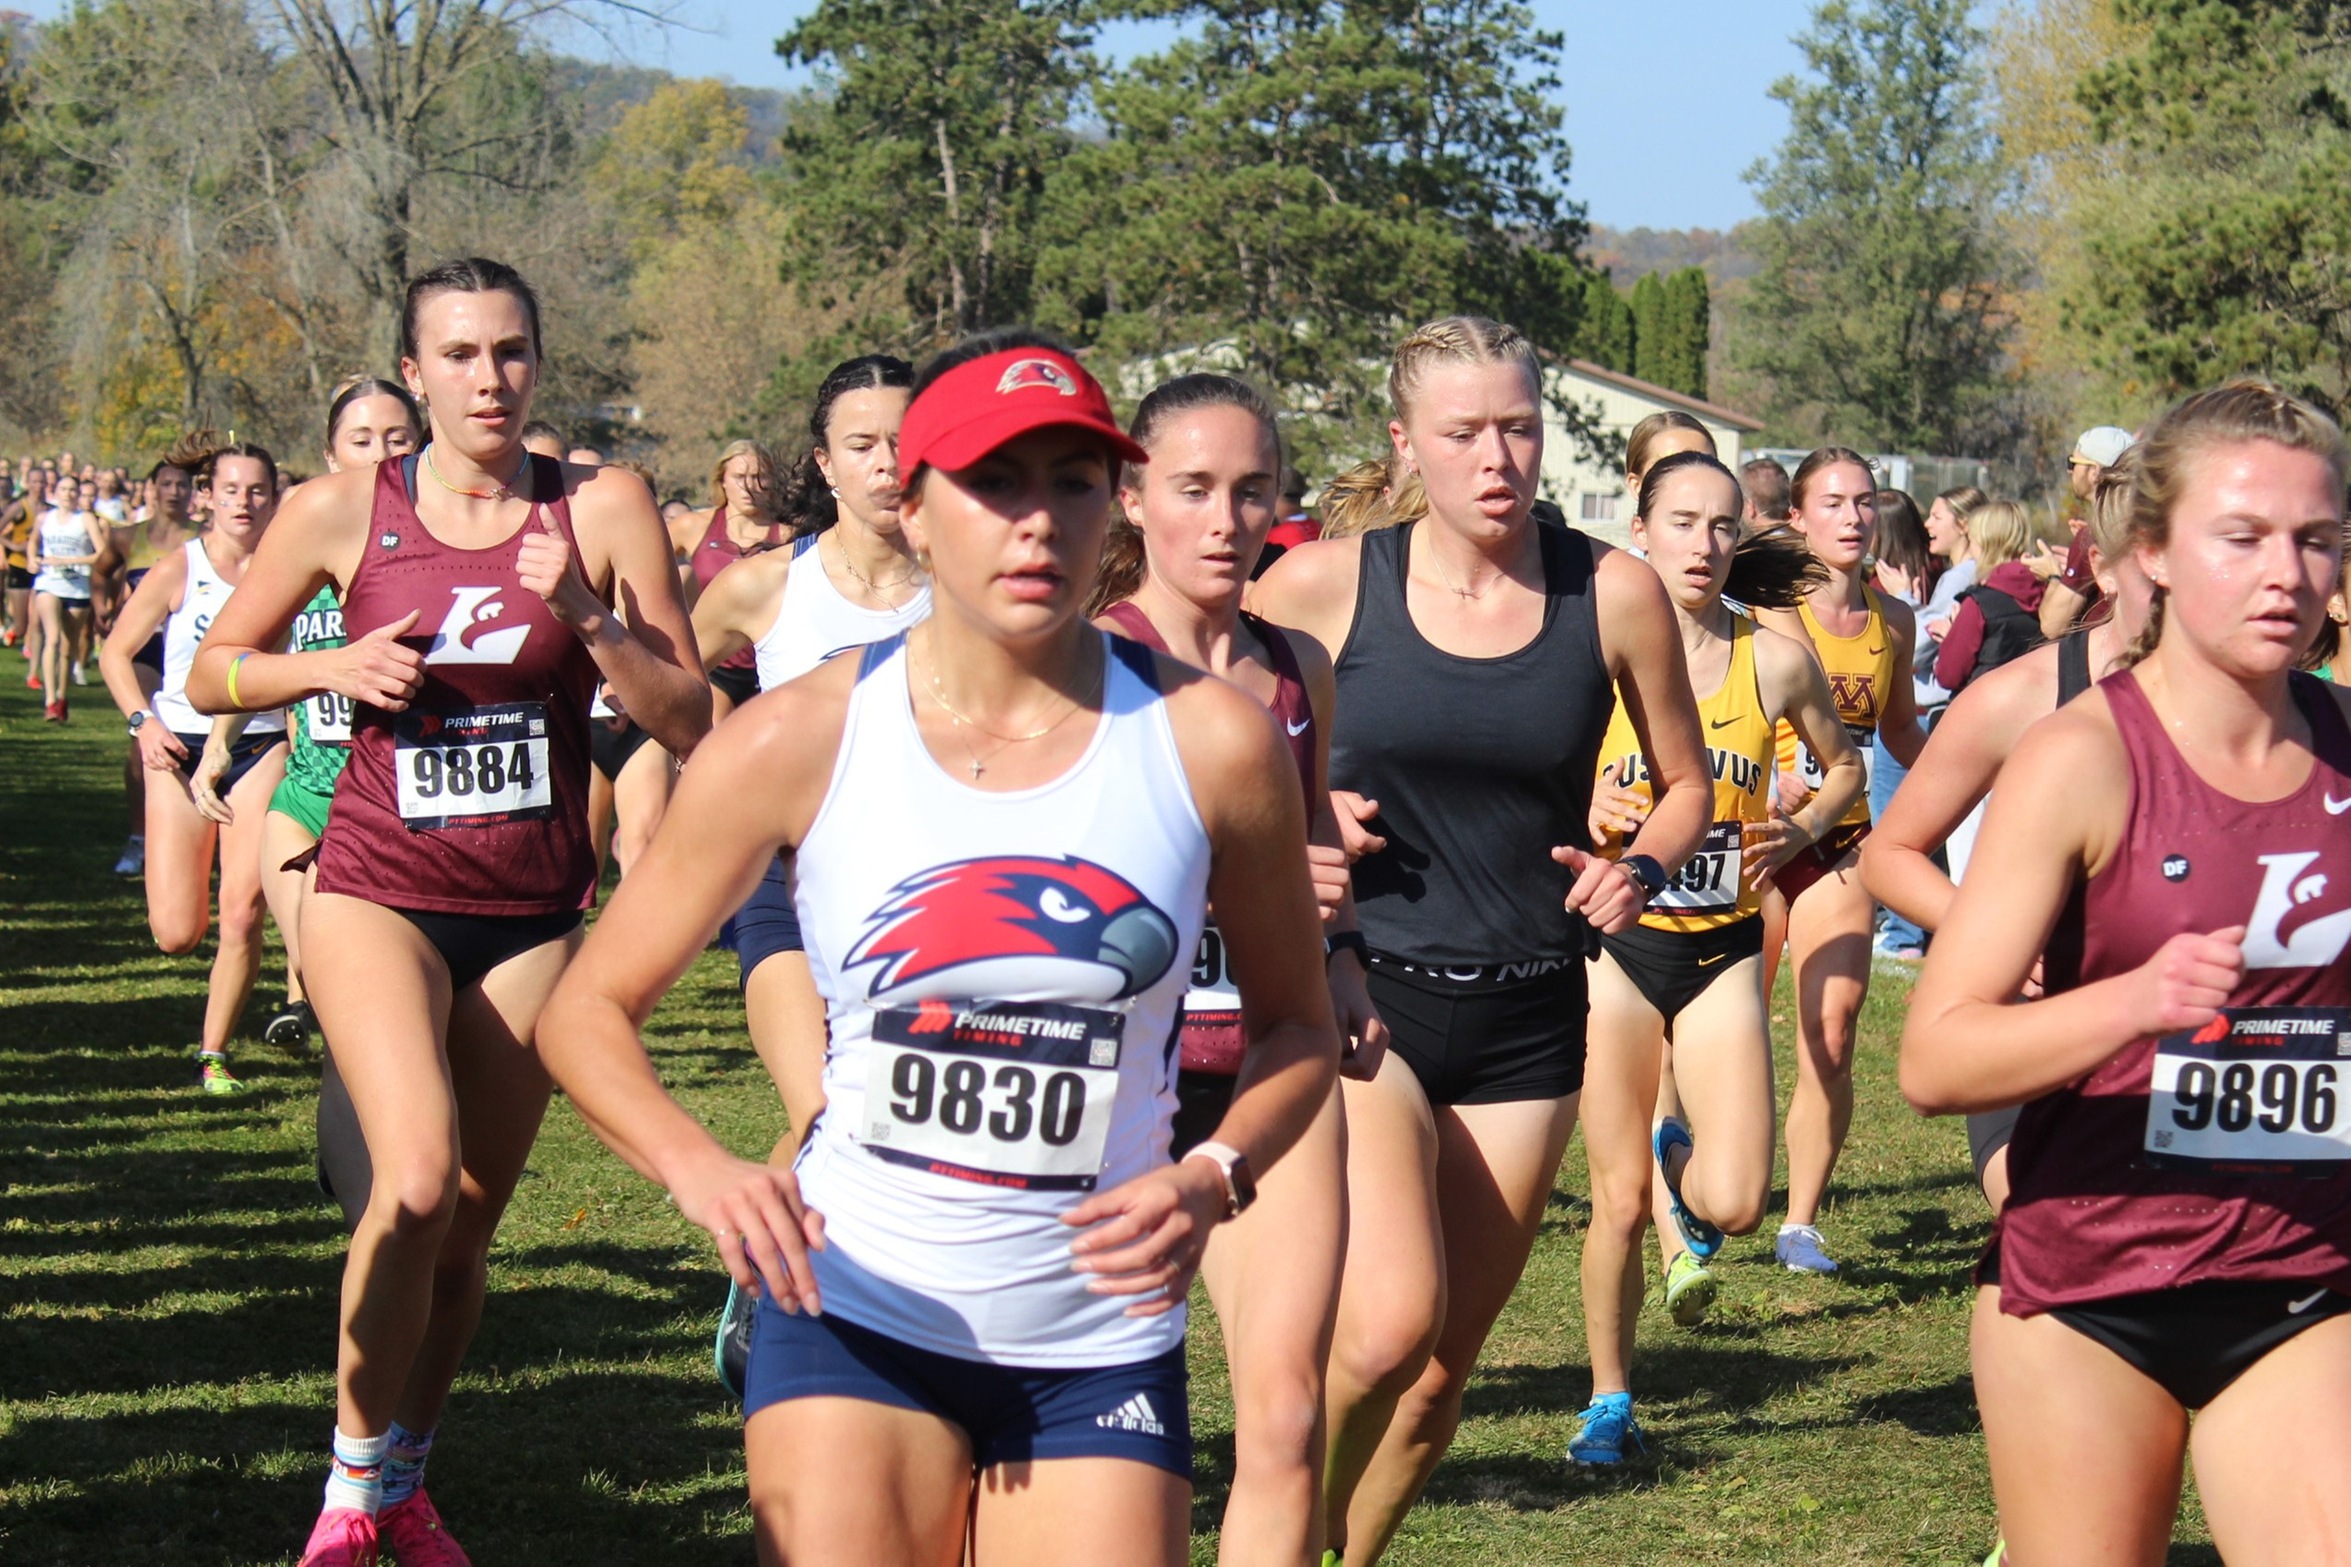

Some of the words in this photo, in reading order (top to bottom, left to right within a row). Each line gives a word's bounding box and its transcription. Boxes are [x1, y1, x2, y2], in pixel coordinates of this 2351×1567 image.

[381, 535, 398, 547] DF
[294, 609, 347, 651] PAR
[445, 712, 524, 729] PRIMETIME
[413, 742, 534, 799] 9884
[2163, 860, 2188, 876] DF
[954, 1011, 1087, 1041] PRIMETIME
[2231, 1019, 2335, 1035] PRIMETIME
[953, 1030, 1023, 1047] TIMING
[889, 1053, 1087, 1147] 9830
[2171, 1061, 2338, 1134] 9896
